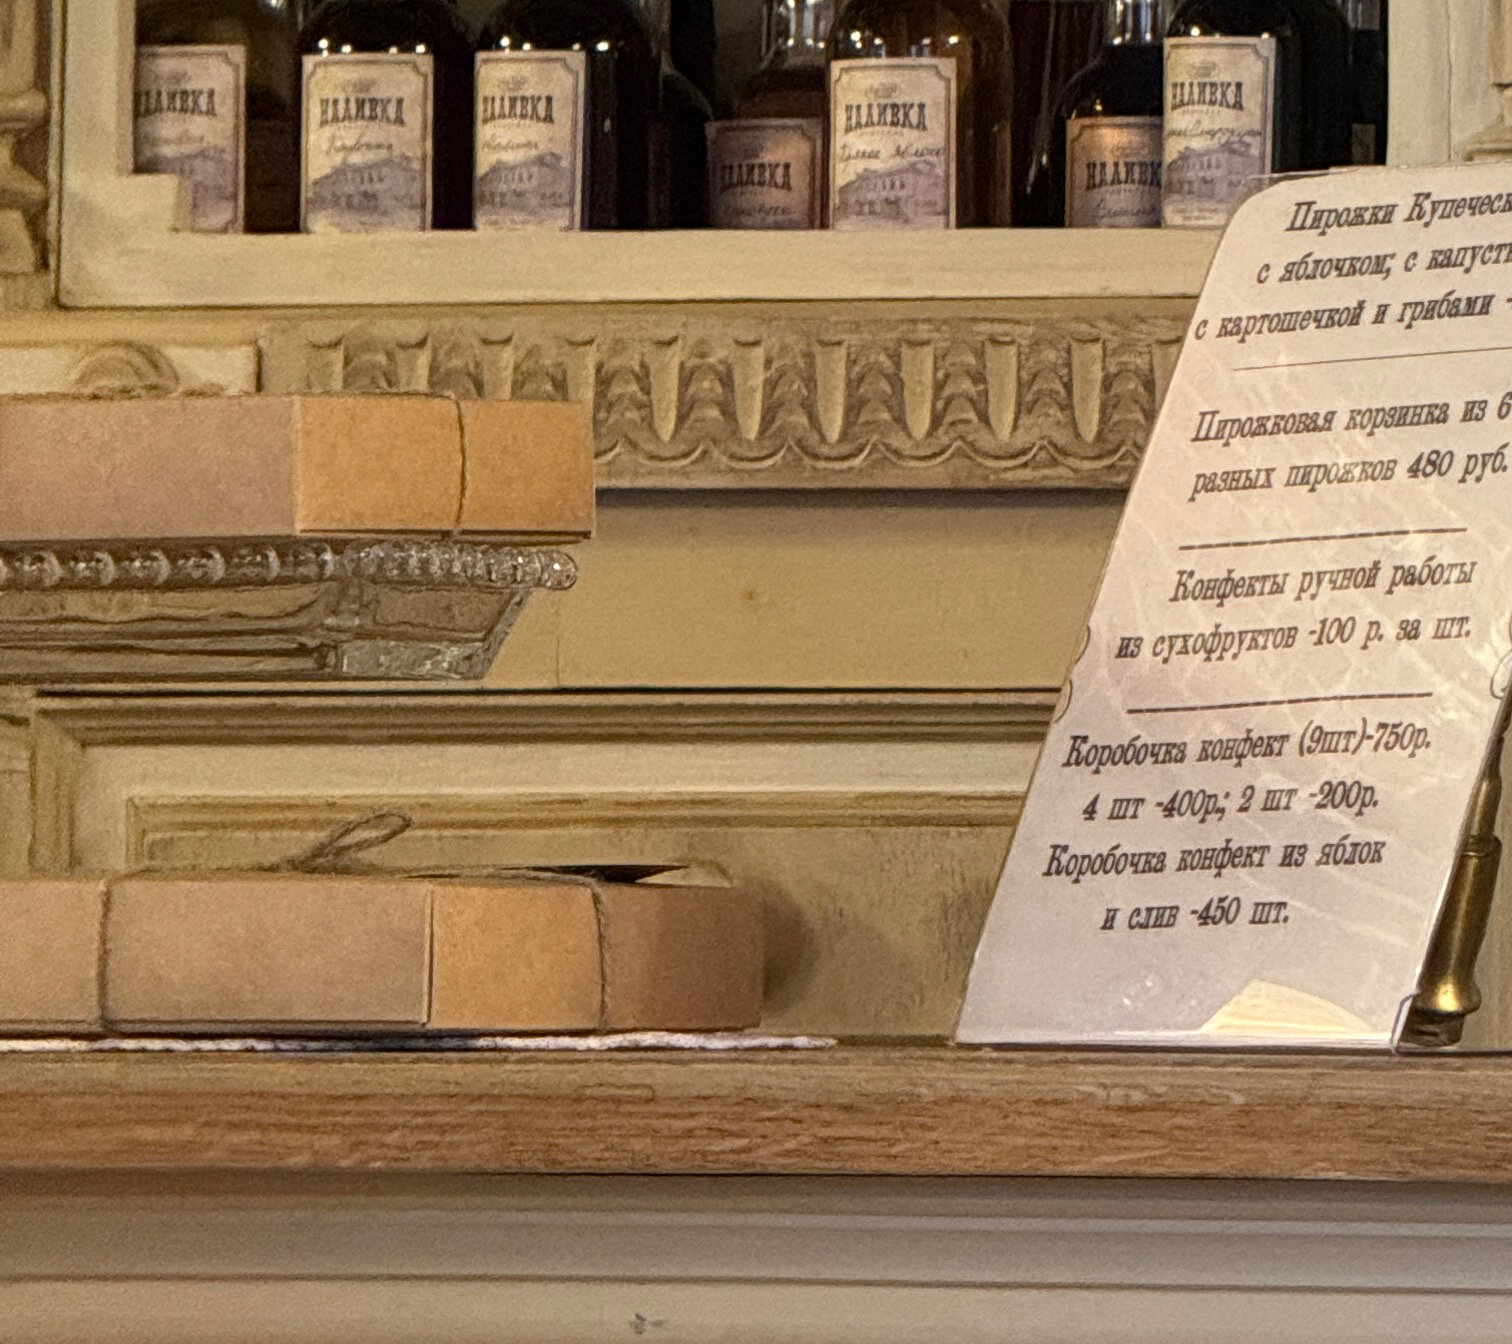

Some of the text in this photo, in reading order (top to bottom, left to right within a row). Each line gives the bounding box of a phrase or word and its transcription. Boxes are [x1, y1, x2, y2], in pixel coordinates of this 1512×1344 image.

[318, 96, 405, 128] НАЛИВКА
[481, 94, 554, 125] НАЛИВКА
[1171, 82, 1244, 112] НАЛИВКА
[844, 102, 929, 134] НАЛИВКА
[1086, 159, 1162, 191] НАЛИВК
[1285, 201, 1398, 235] Пирожки
[1256, 264, 1271, 283] с
[1278, 250, 1395, 284] яблочком;
[1403, 253, 1416, 272] с
[1194, 321, 1207, 340] с
[1216, 299, 1367, 344] картошечкой
[1371, 303, 1388, 324] и
[1397, 290, 1495, 329] грибами
[1190, 409, 1338, 447] Пирожковая
[1344, 401, 1451, 437] корзинка
[1460, 399, 1488, 423] из
[1188, 442, 1511, 502] разных пирожков 480 руб.
[1168, 555, 1478, 608] Конфекты ручной работы
[1115, 616, 1472, 664] из сухофруктов -100 р. за шт.
[1061, 717, 1432, 775] Коробочка конфект (9шт)-750р.
[1082, 793, 1100, 821] 4
[1106, 797, 1146, 821] шт
[1236, 784, 1255, 813] 2
[1260, 787, 1299, 812] шт
[1308, 780, 1379, 817] -200р.
[1042, 833, 1387, 884] Коробочка конфект из яблок
[1099, 896, 1290, 931] и слив -450 шт.
